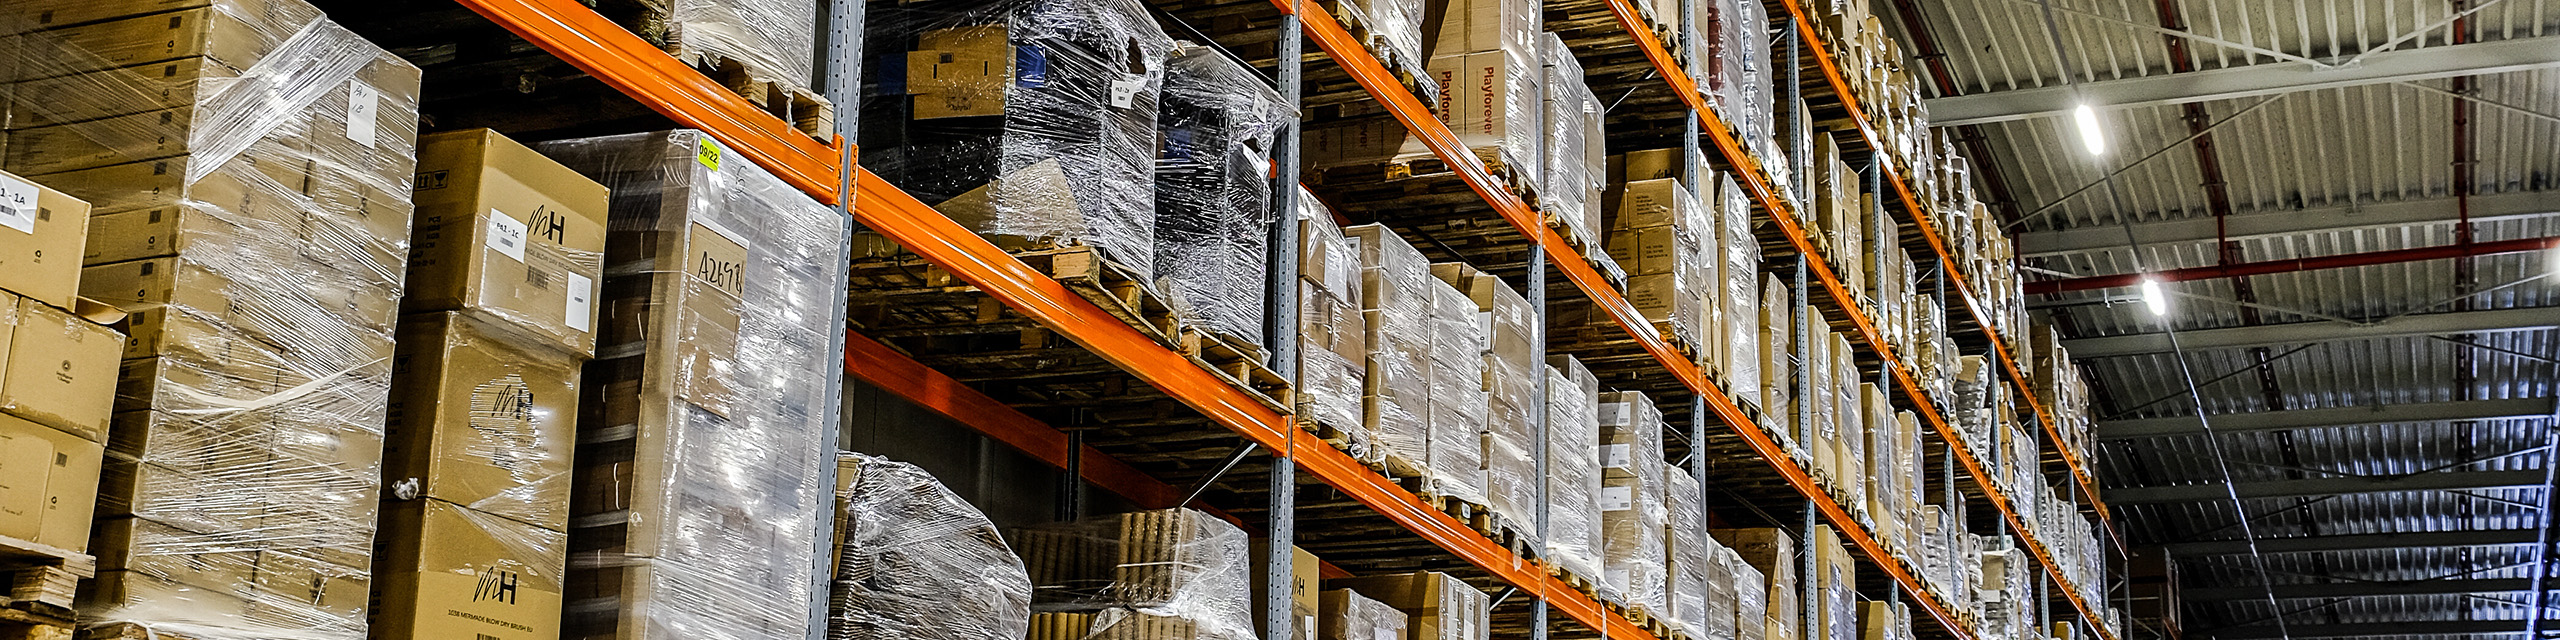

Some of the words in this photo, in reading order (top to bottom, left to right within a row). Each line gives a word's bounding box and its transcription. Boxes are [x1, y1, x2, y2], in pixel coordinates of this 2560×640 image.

[1481, 67, 1494, 135] Playforever
[699, 144, 718, 163] 09/22
[486, 617, 500, 625] BLOW
